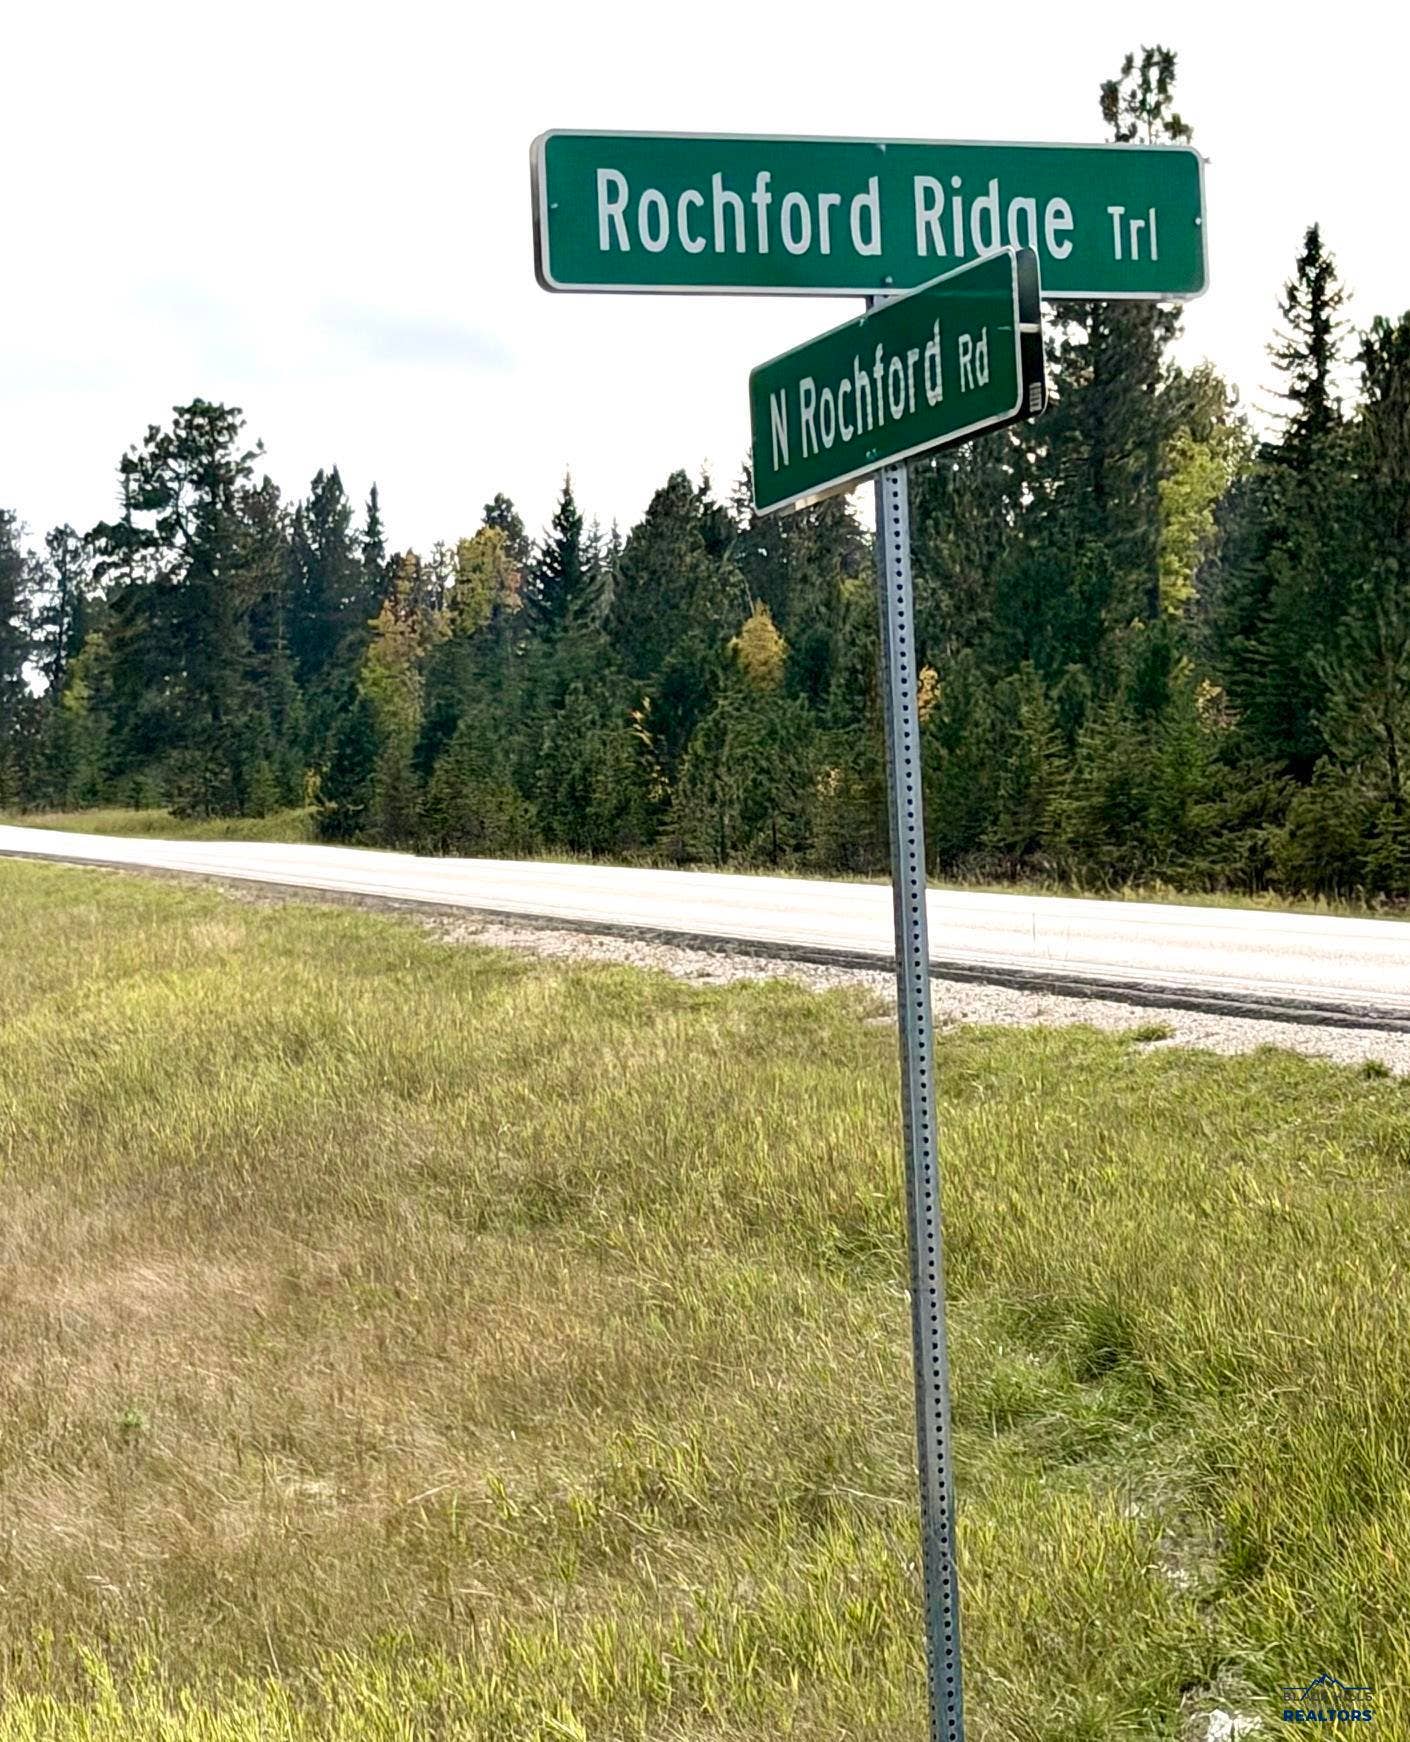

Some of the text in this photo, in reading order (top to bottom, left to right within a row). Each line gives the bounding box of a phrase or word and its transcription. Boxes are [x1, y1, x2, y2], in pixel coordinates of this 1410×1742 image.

[596, 167, 883, 257] Rochford
[1106, 205, 1159, 261] Trl
[769, 317, 990, 472] N Rochford Rd
